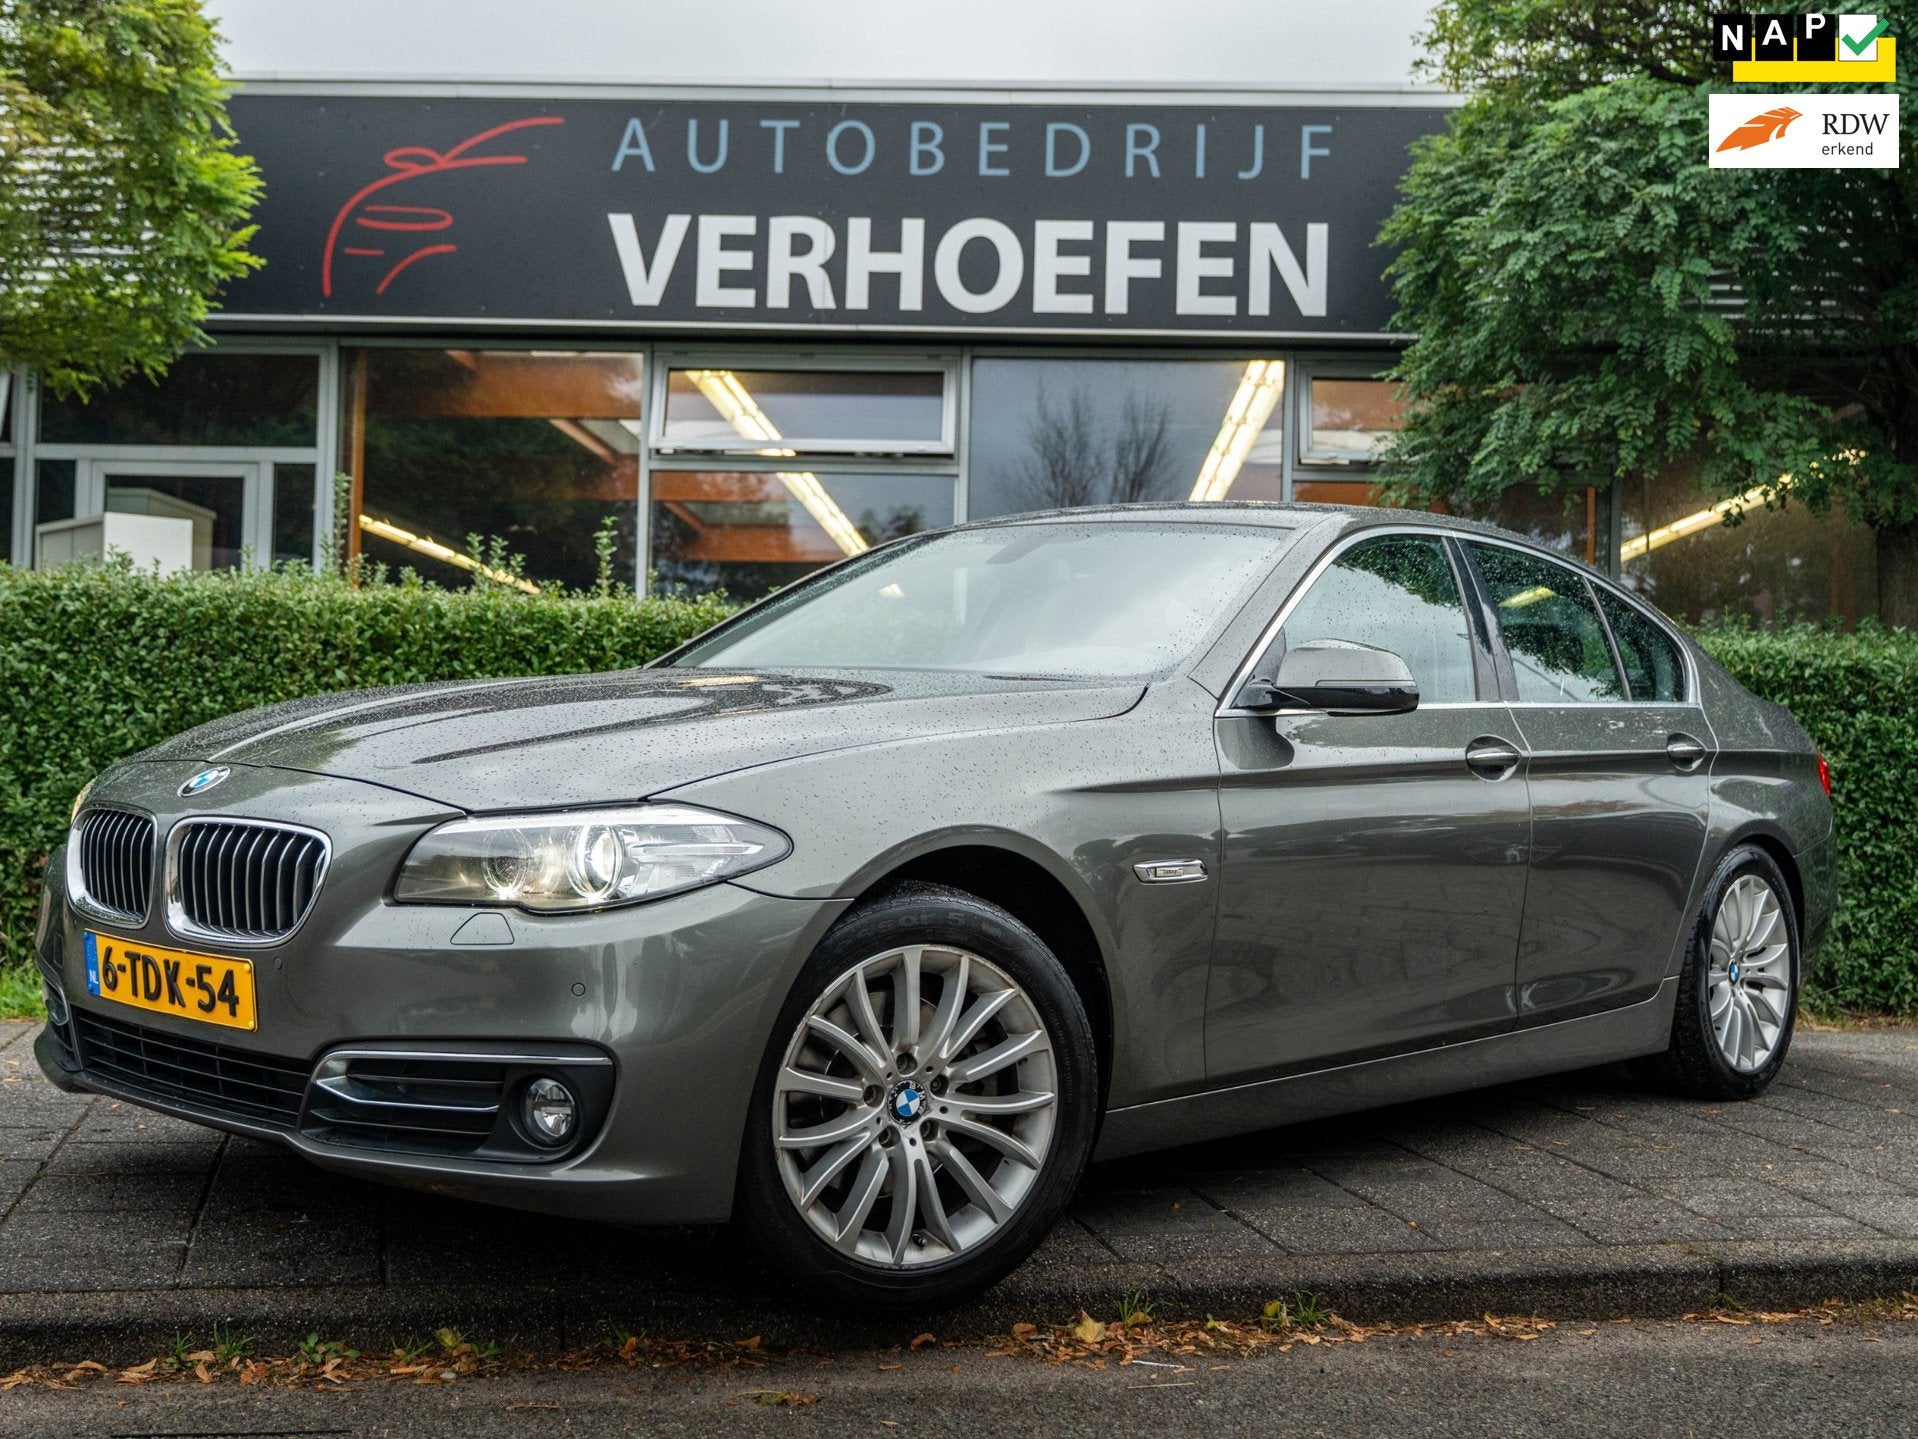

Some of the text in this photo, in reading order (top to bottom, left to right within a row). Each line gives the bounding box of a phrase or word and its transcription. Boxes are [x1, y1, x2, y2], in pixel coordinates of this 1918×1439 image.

[611, 118, 1333, 180] AUTOBEDRIJF
[607, 213, 1329, 317] VERHOEFEN
[89, 969, 99, 985] NL
[102, 946, 240, 1017] 6-TDK-54
